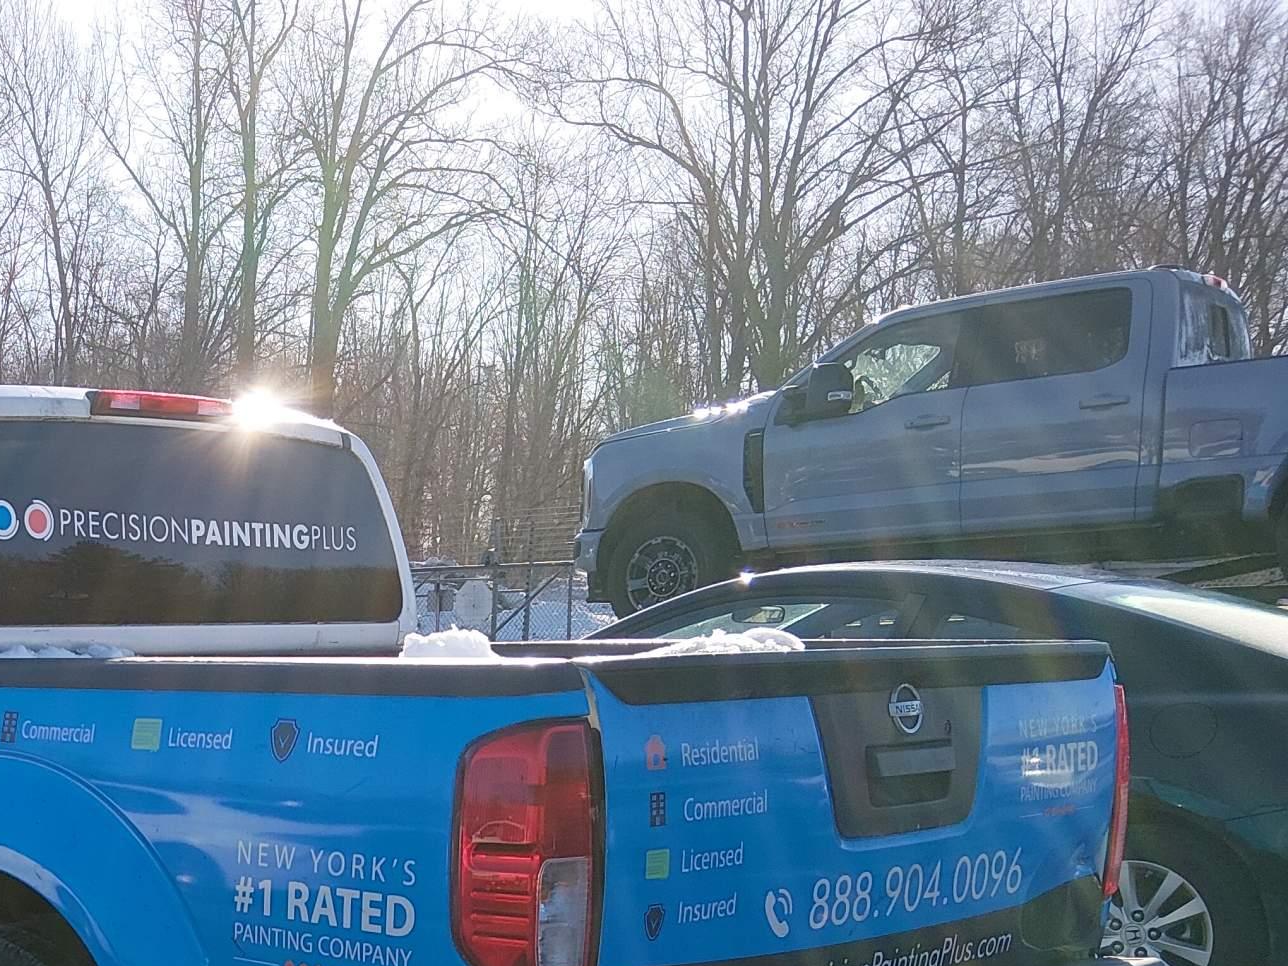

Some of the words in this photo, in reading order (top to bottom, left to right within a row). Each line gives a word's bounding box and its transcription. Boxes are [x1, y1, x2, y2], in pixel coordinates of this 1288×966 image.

[22, 720, 95, 744] Commercial
[168, 727, 233, 750] Licensed
[307, 732, 379, 757] Insured
[1019, 719, 1048, 738] NEW
[681, 736, 759, 767] Residential
[1046, 740, 1098, 773] RATED
[684, 789, 768, 821] Commercial
[237, 840, 296, 870] NEW
[310, 848, 416, 886] YORK'S
[681, 840, 744, 873] Licensed
[809, 847, 1023, 930] 888.904.0096
[234, 876, 272, 917] #1
[287, 881, 416, 937] RATED
[678, 892, 737, 924] Insured
[233, 922, 312, 953] PAINTING
